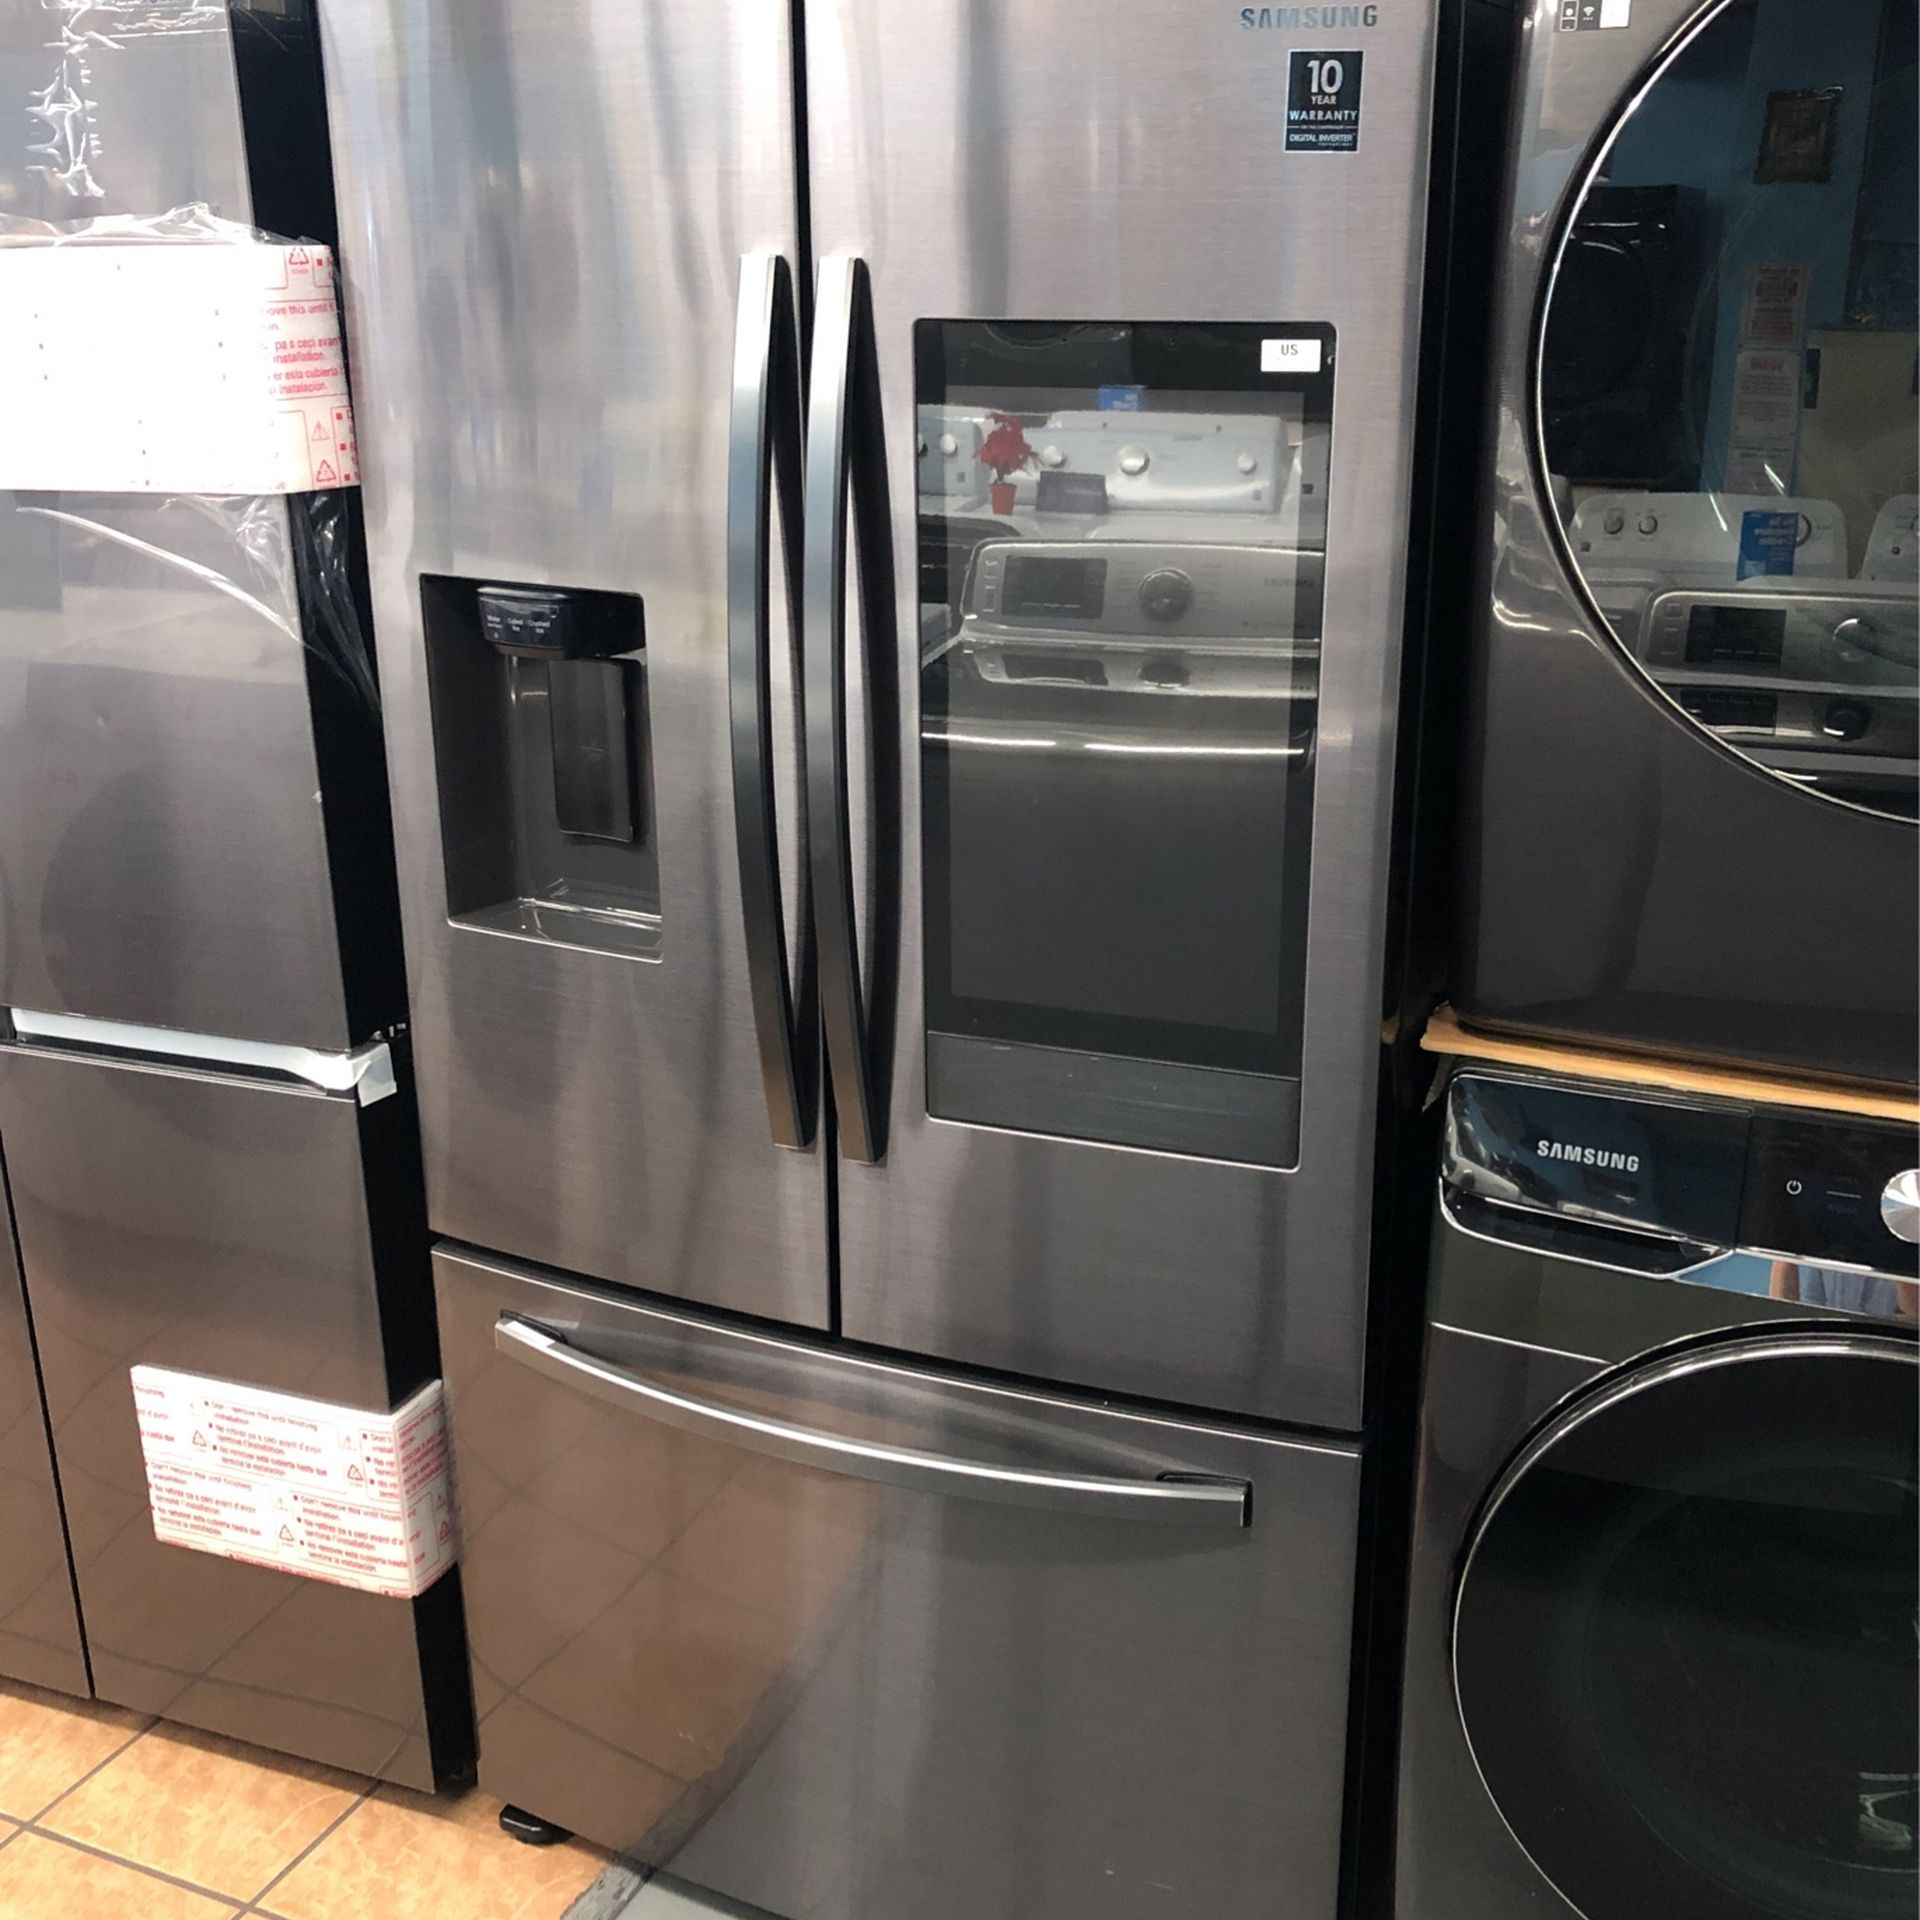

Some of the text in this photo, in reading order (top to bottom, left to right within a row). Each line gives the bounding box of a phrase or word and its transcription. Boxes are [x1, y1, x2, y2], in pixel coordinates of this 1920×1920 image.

[1241, 5, 1378, 29] SAMSUNG
[1307, 59, 1343, 94] 10
[1311, 95, 1337, 105] YEAR
[1289, 111, 1358, 120] WARRANTY
[1289, 134, 1317, 142] DIGITAL
[1281, 344, 1298, 356] US
[1537, 1140, 1639, 1172] SAMSUNG
